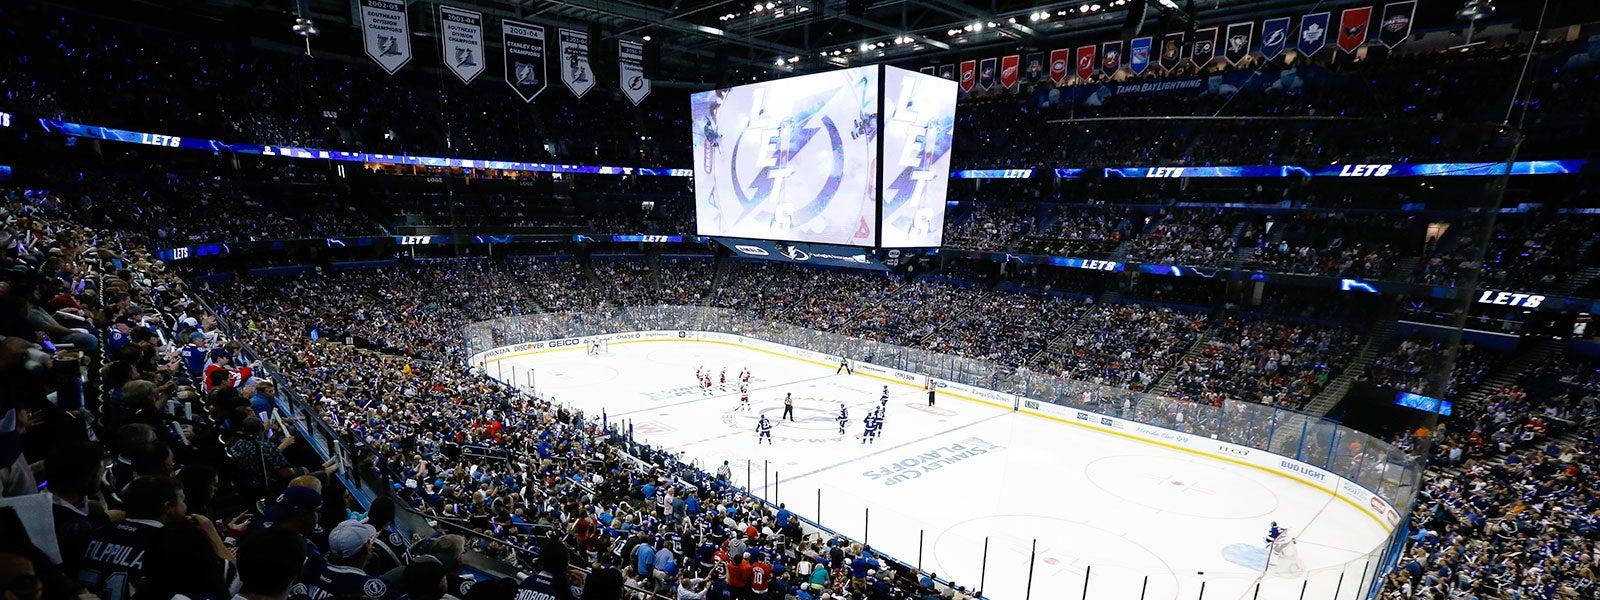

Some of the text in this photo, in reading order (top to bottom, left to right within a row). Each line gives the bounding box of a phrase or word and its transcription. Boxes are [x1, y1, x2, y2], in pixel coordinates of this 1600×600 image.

[367, 11, 402, 21] SOUTHEAST
[447, 14, 475, 25] 2003-04
[372, 19, 398, 27] DIVISION
[368, 24, 403, 34] CHAMPIONS
[447, 25, 477, 34] SOUTHEAST
[510, 27, 538, 38] 2003-04
[451, 32, 474, 40] DIVISION
[448, 37, 478, 46] CHAMPIONS
[507, 41, 530, 50] STANLEY
[509, 48, 541, 58] CHAMPIONS
[1117, 79, 1202, 95] TAMPA BAY LIGHTNING
[142, 133, 181, 147] LETS
[1003, 169, 1032, 178] LETS
[1146, 167, 1184, 178] LETS
[1339, 164, 1392, 177] LETS
[401, 236, 431, 245] LETS
[642, 235, 669, 243] LETS
[173, 247, 189, 260] LETS
[1081, 259, 1116, 271] LETS
[1478, 290, 1545, 309] LETS
[514, 342, 545, 352] DISCOVER
[549, 338, 579, 348] GEICO
[862, 443, 967, 480] PLAYOFFS
[885, 446, 988, 486] STANLEY CUP
[1280, 460, 1326, 482] BUD LIGHT
[85, 540, 145, 570] FILPPULA
